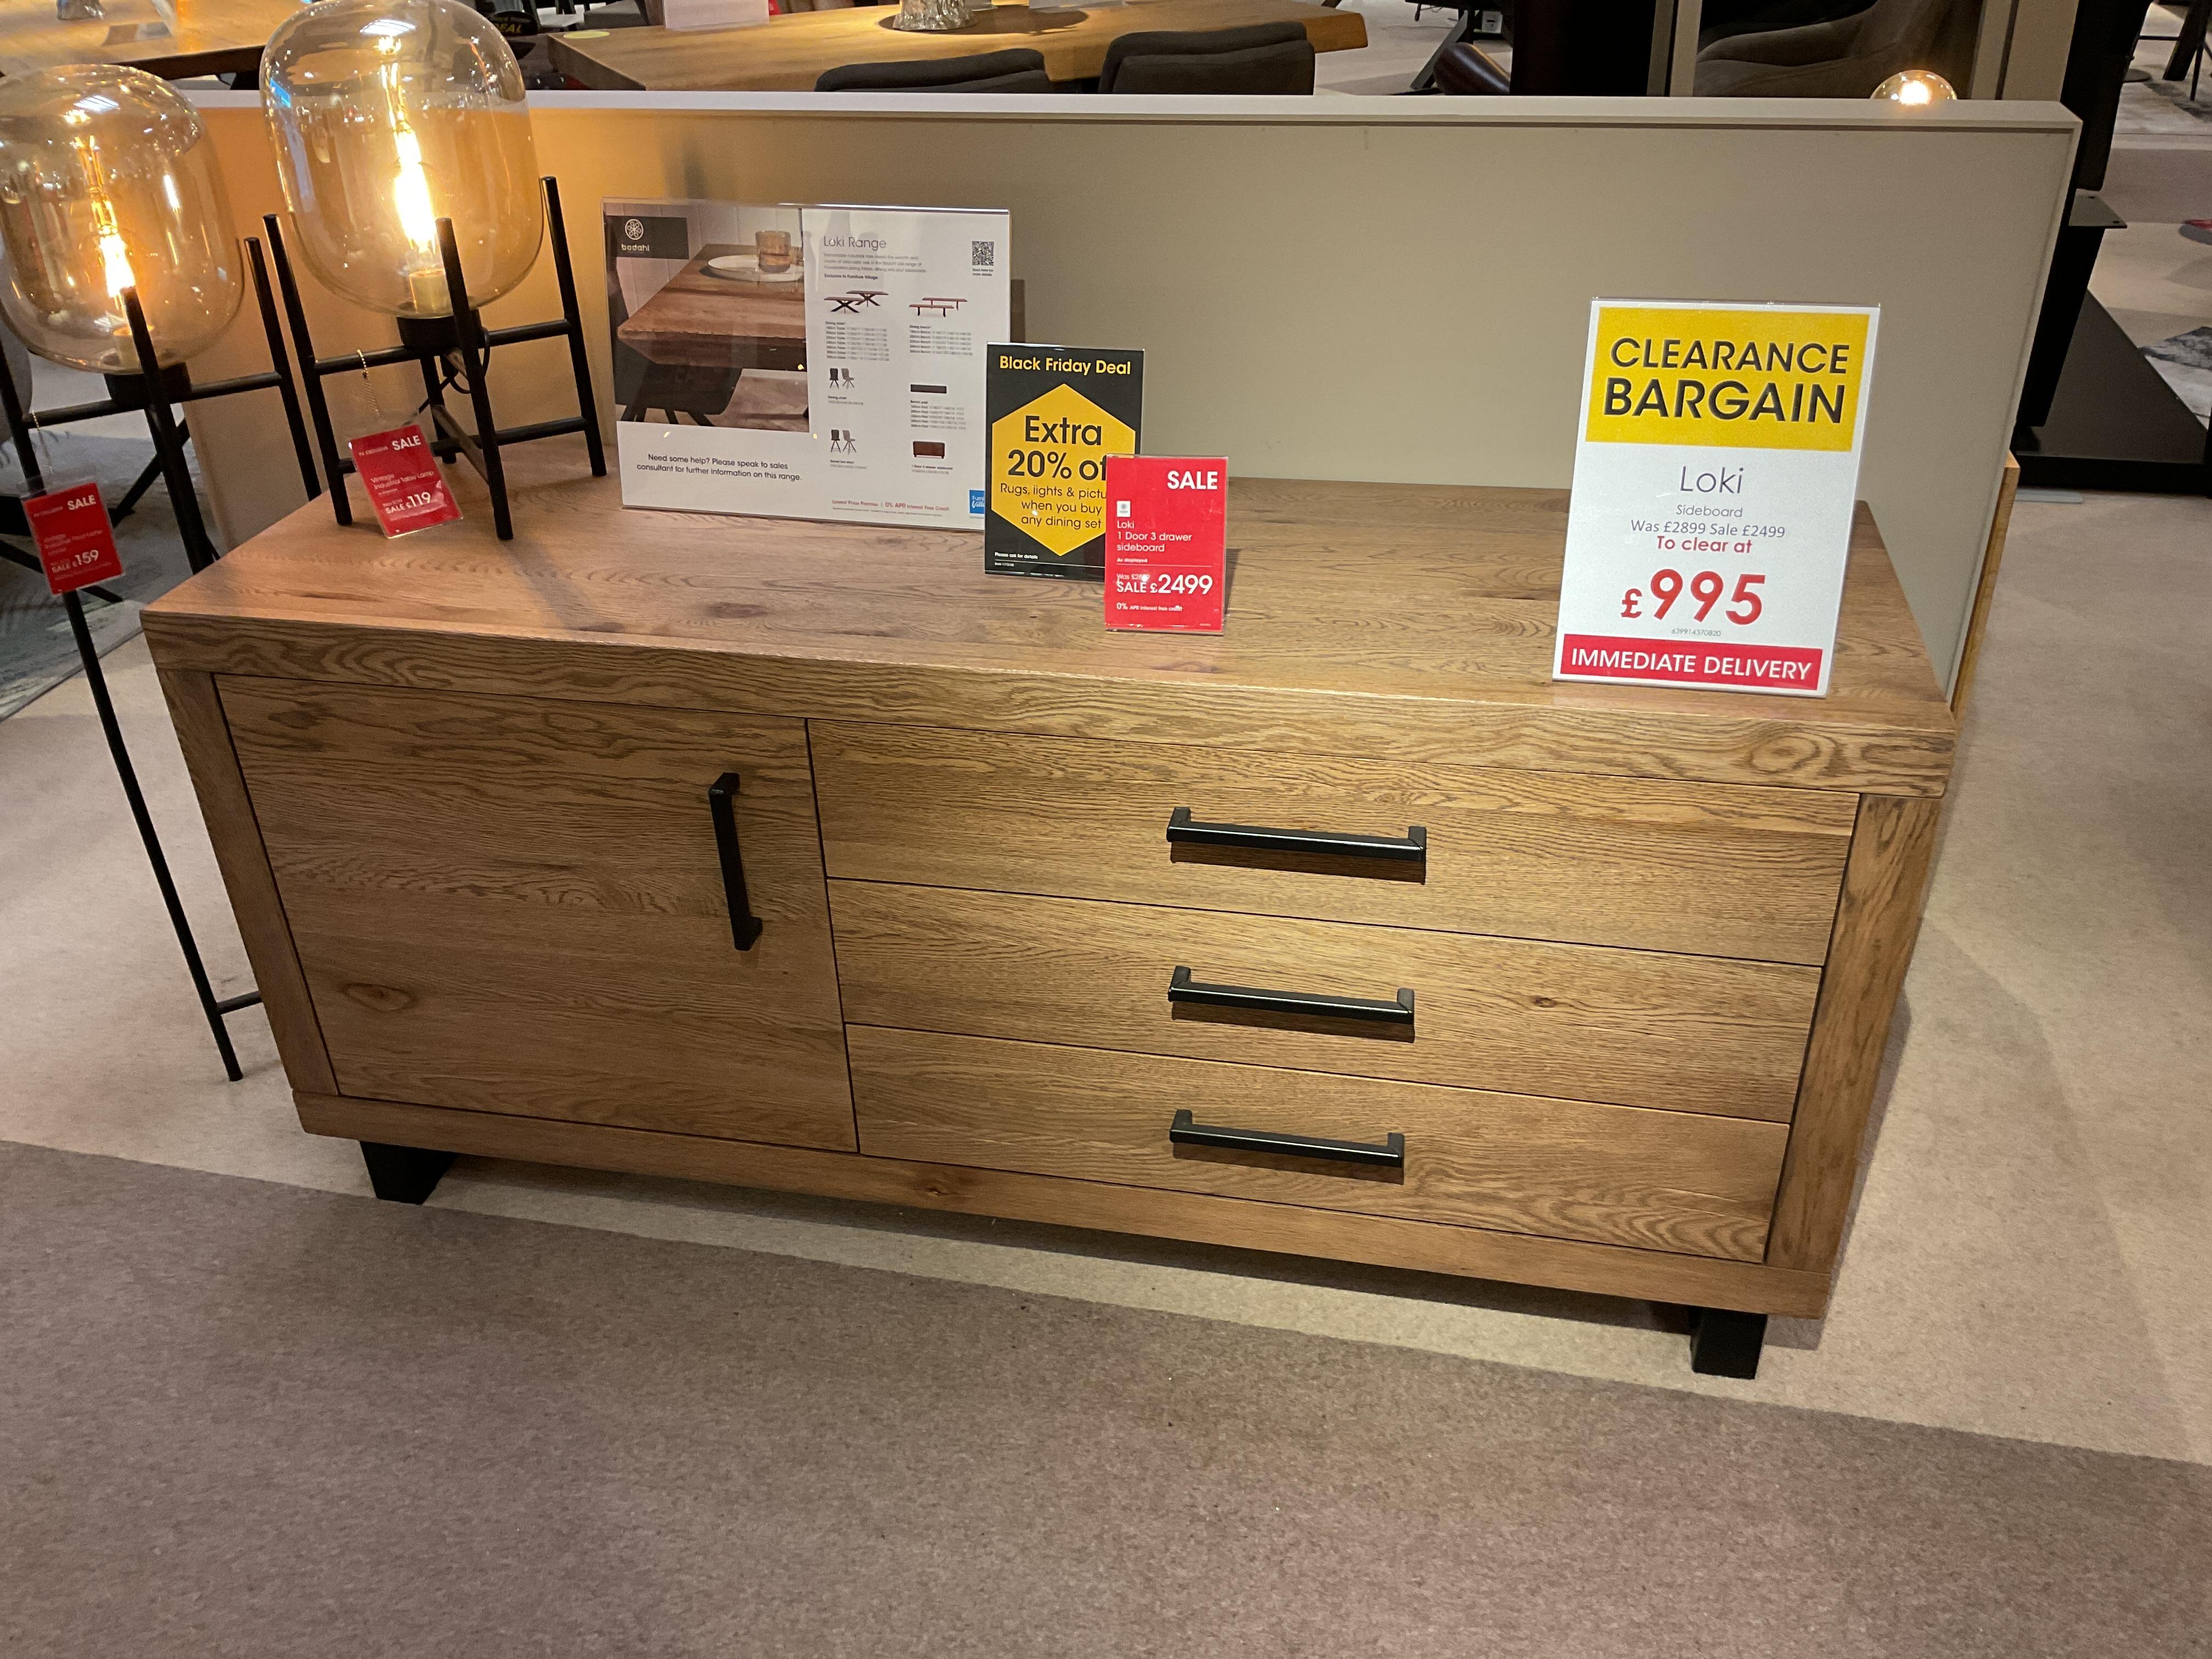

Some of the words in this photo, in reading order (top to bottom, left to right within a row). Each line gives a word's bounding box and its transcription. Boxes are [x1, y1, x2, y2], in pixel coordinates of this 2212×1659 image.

[621, 244, 650, 252] bodahl
[823, 236, 845, 247] Loki
[849, 236, 887, 251] Range
[1611, 337, 1849, 374] CLEARANCE
[1000, 356, 1041, 370] Black
[1046, 358, 1091, 376] Friday
[1096, 359, 1131, 375] Deal
[1604, 377, 1845, 424] BARGAIN
[1025, 415, 1102, 445] Extra
[392, 436, 421, 450] SALE
[648, 454, 668, 462] Need
[690, 456, 710, 465] help?
[712, 458, 735, 466] Please
[1008, 449, 1072, 479] 20%
[1079, 455, 1107, 481] of
[636, 464, 674, 472] consultant
[686, 466, 709, 475] further
[711, 468, 751, 478] information
[764, 471, 777, 479] this
[1167, 470, 1218, 490] SALE
[1680, 466, 1744, 493] Loki
[1000, 483, 1030, 496] Rugs,
[1033, 484, 1062, 498] lights
[1066, 487, 1074, 497] &
[1079, 488, 1107, 500] pictu
[67, 495, 96, 510] SALE
[385, 504, 405, 514] SALE
[407, 492, 431, 509] £119
[1021, 500, 1052, 511] when
[1056, 504, 1076, 514] you
[1081, 503, 1102, 516] buy
[1676, 505, 1743, 517] Sideboard
[1021, 516, 1042, 527] any
[1046, 516, 1081, 529] dining
[1085, 519, 1102, 528] set
[1116, 520, 1135, 529] Loki
[1630, 520, 1659, 532] Was
[1663, 522, 1706, 534] £2899
[1709, 523, 1737, 535] Sale
[1741, 525, 1785, 538] £2499
[1118, 532, 1122, 540] 1
[1125, 532, 1148, 541] Door
[1150, 532, 1156, 541] 3
[1159, 533, 1193, 541] drawer
[1657, 535, 1675, 549] To
[1681, 537, 1728, 552] clear
[1734, 539, 1753, 554] at
[1116, 543, 1165, 552] sideboard
[52, 563, 71, 573] SALE
[1117, 582, 1147, 592] SALE
[1150, 574, 1213, 595] £2499
[1621, 568, 1766, 625] £995
[1572, 648, 1696, 673] IMMEDIATE
[1704, 657, 1812, 680] DELIVERY
